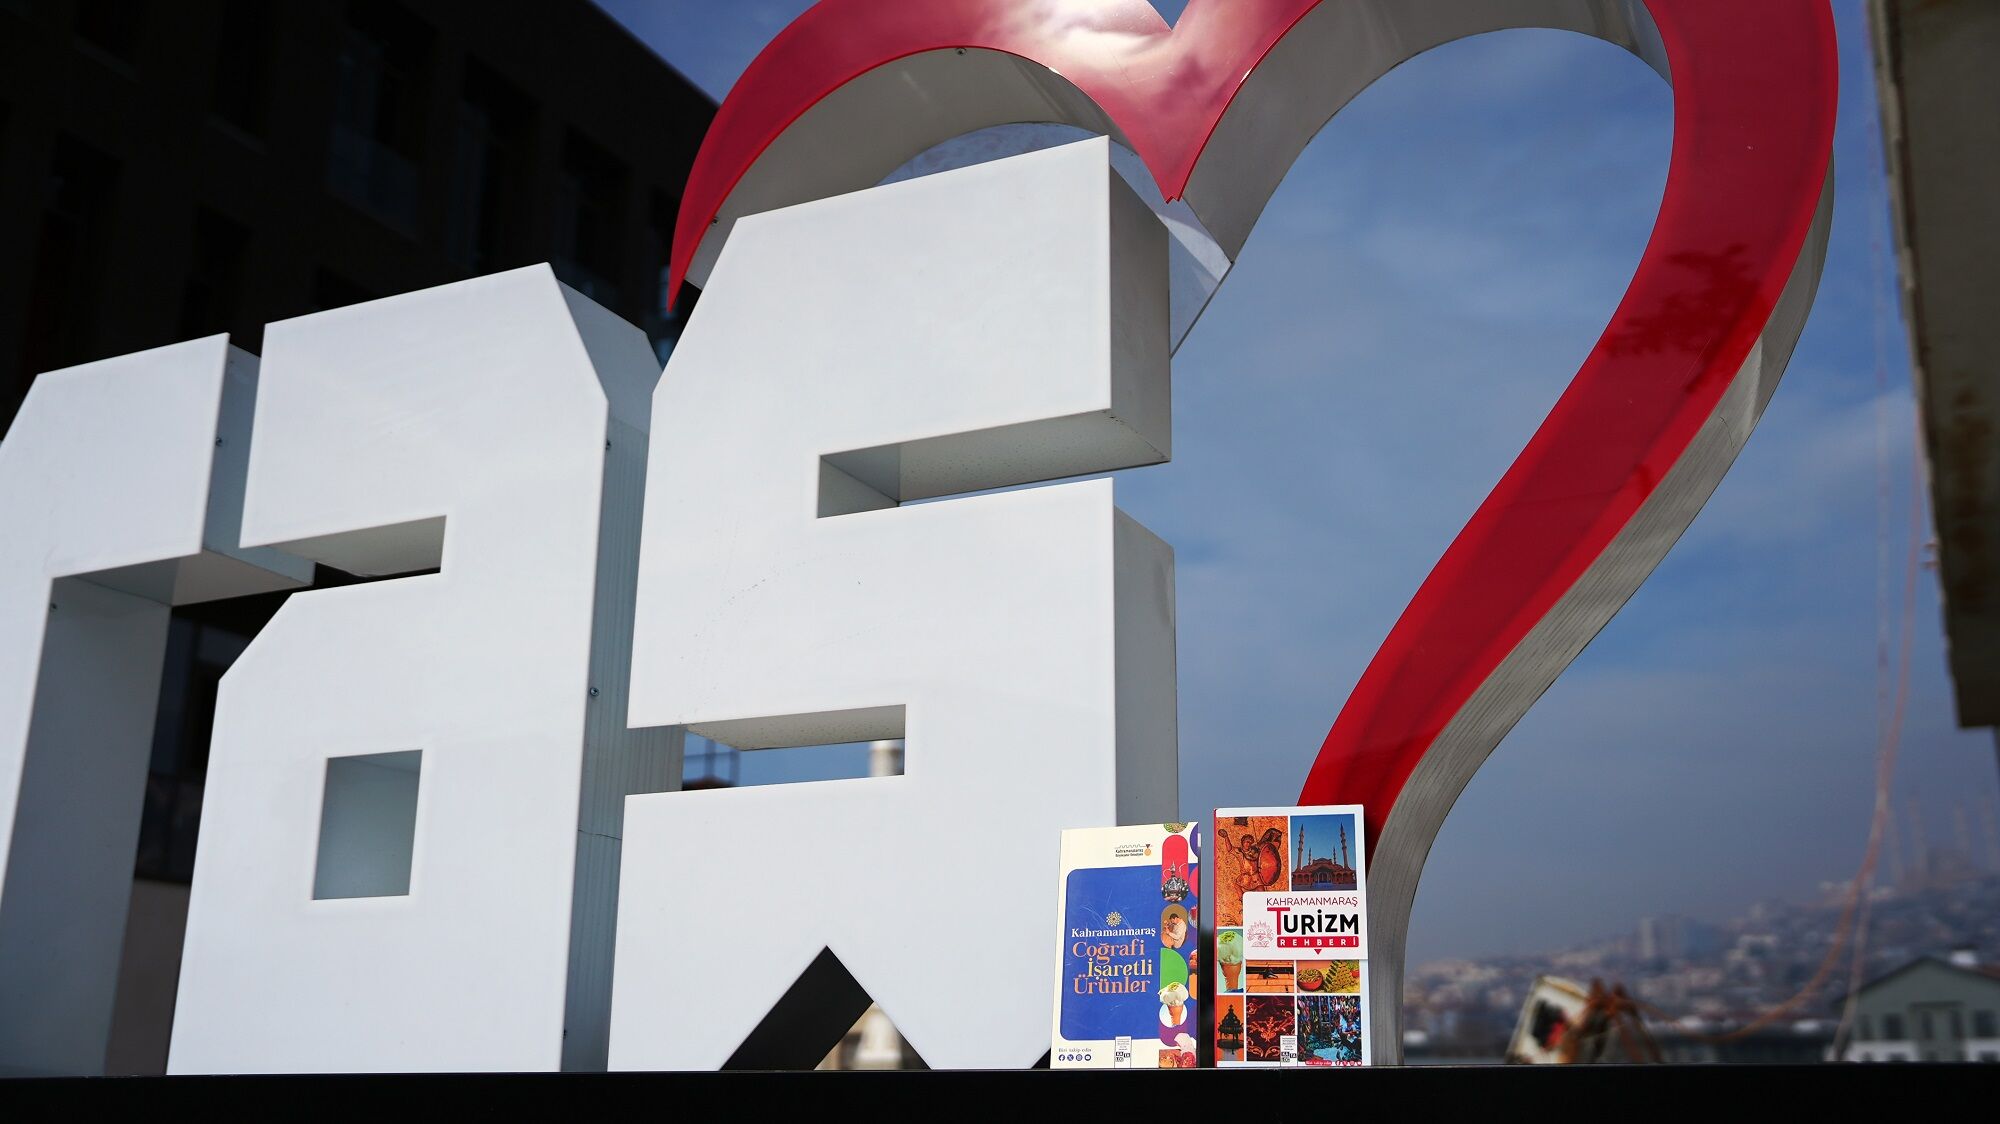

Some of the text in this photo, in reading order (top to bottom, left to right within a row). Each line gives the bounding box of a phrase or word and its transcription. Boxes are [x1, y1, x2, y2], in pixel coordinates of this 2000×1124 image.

[1266, 896, 1358, 907] KAHRAMANMARAŞ
[1071, 927, 1156, 937] Kahramanmaraş
[1267, 907, 1359, 935] TURİZM
[1072, 938, 1145, 965] Coğrafi
[1280, 936, 1356, 946] REHBERİ
[1087, 957, 1153, 980] İşaretli
[1073, 973, 1151, 995] Ürünler
